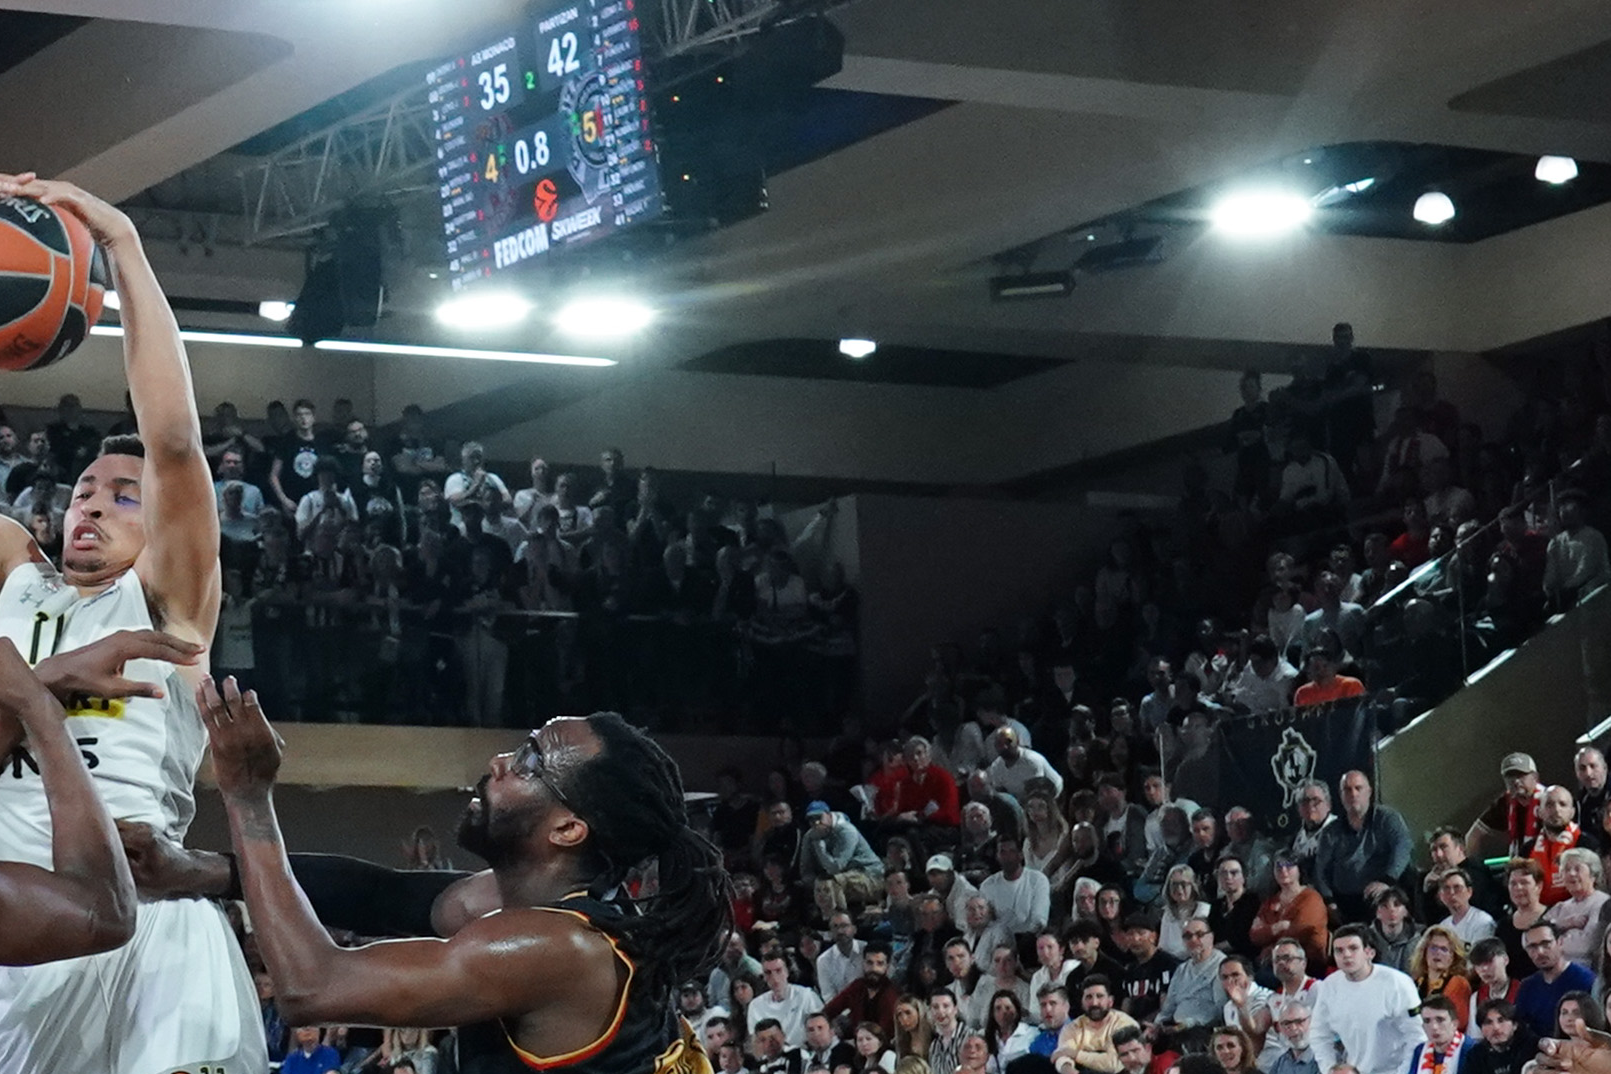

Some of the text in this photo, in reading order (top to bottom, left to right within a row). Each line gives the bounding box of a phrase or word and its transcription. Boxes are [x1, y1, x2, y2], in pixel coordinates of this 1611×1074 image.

[538, 7, 579, 34] PARTIZAN
[482, 36, 517, 60] MONACO
[547, 31, 581, 78] 42
[478, 63, 511, 111] 35
[525, 70, 536, 90] 2
[581, 110, 599, 144] 5
[484, 153, 500, 184] 4
[513, 130, 551, 174] 0.8
[550, 205, 603, 242] SKWEEK
[492, 222, 550, 270] FEDCOM
